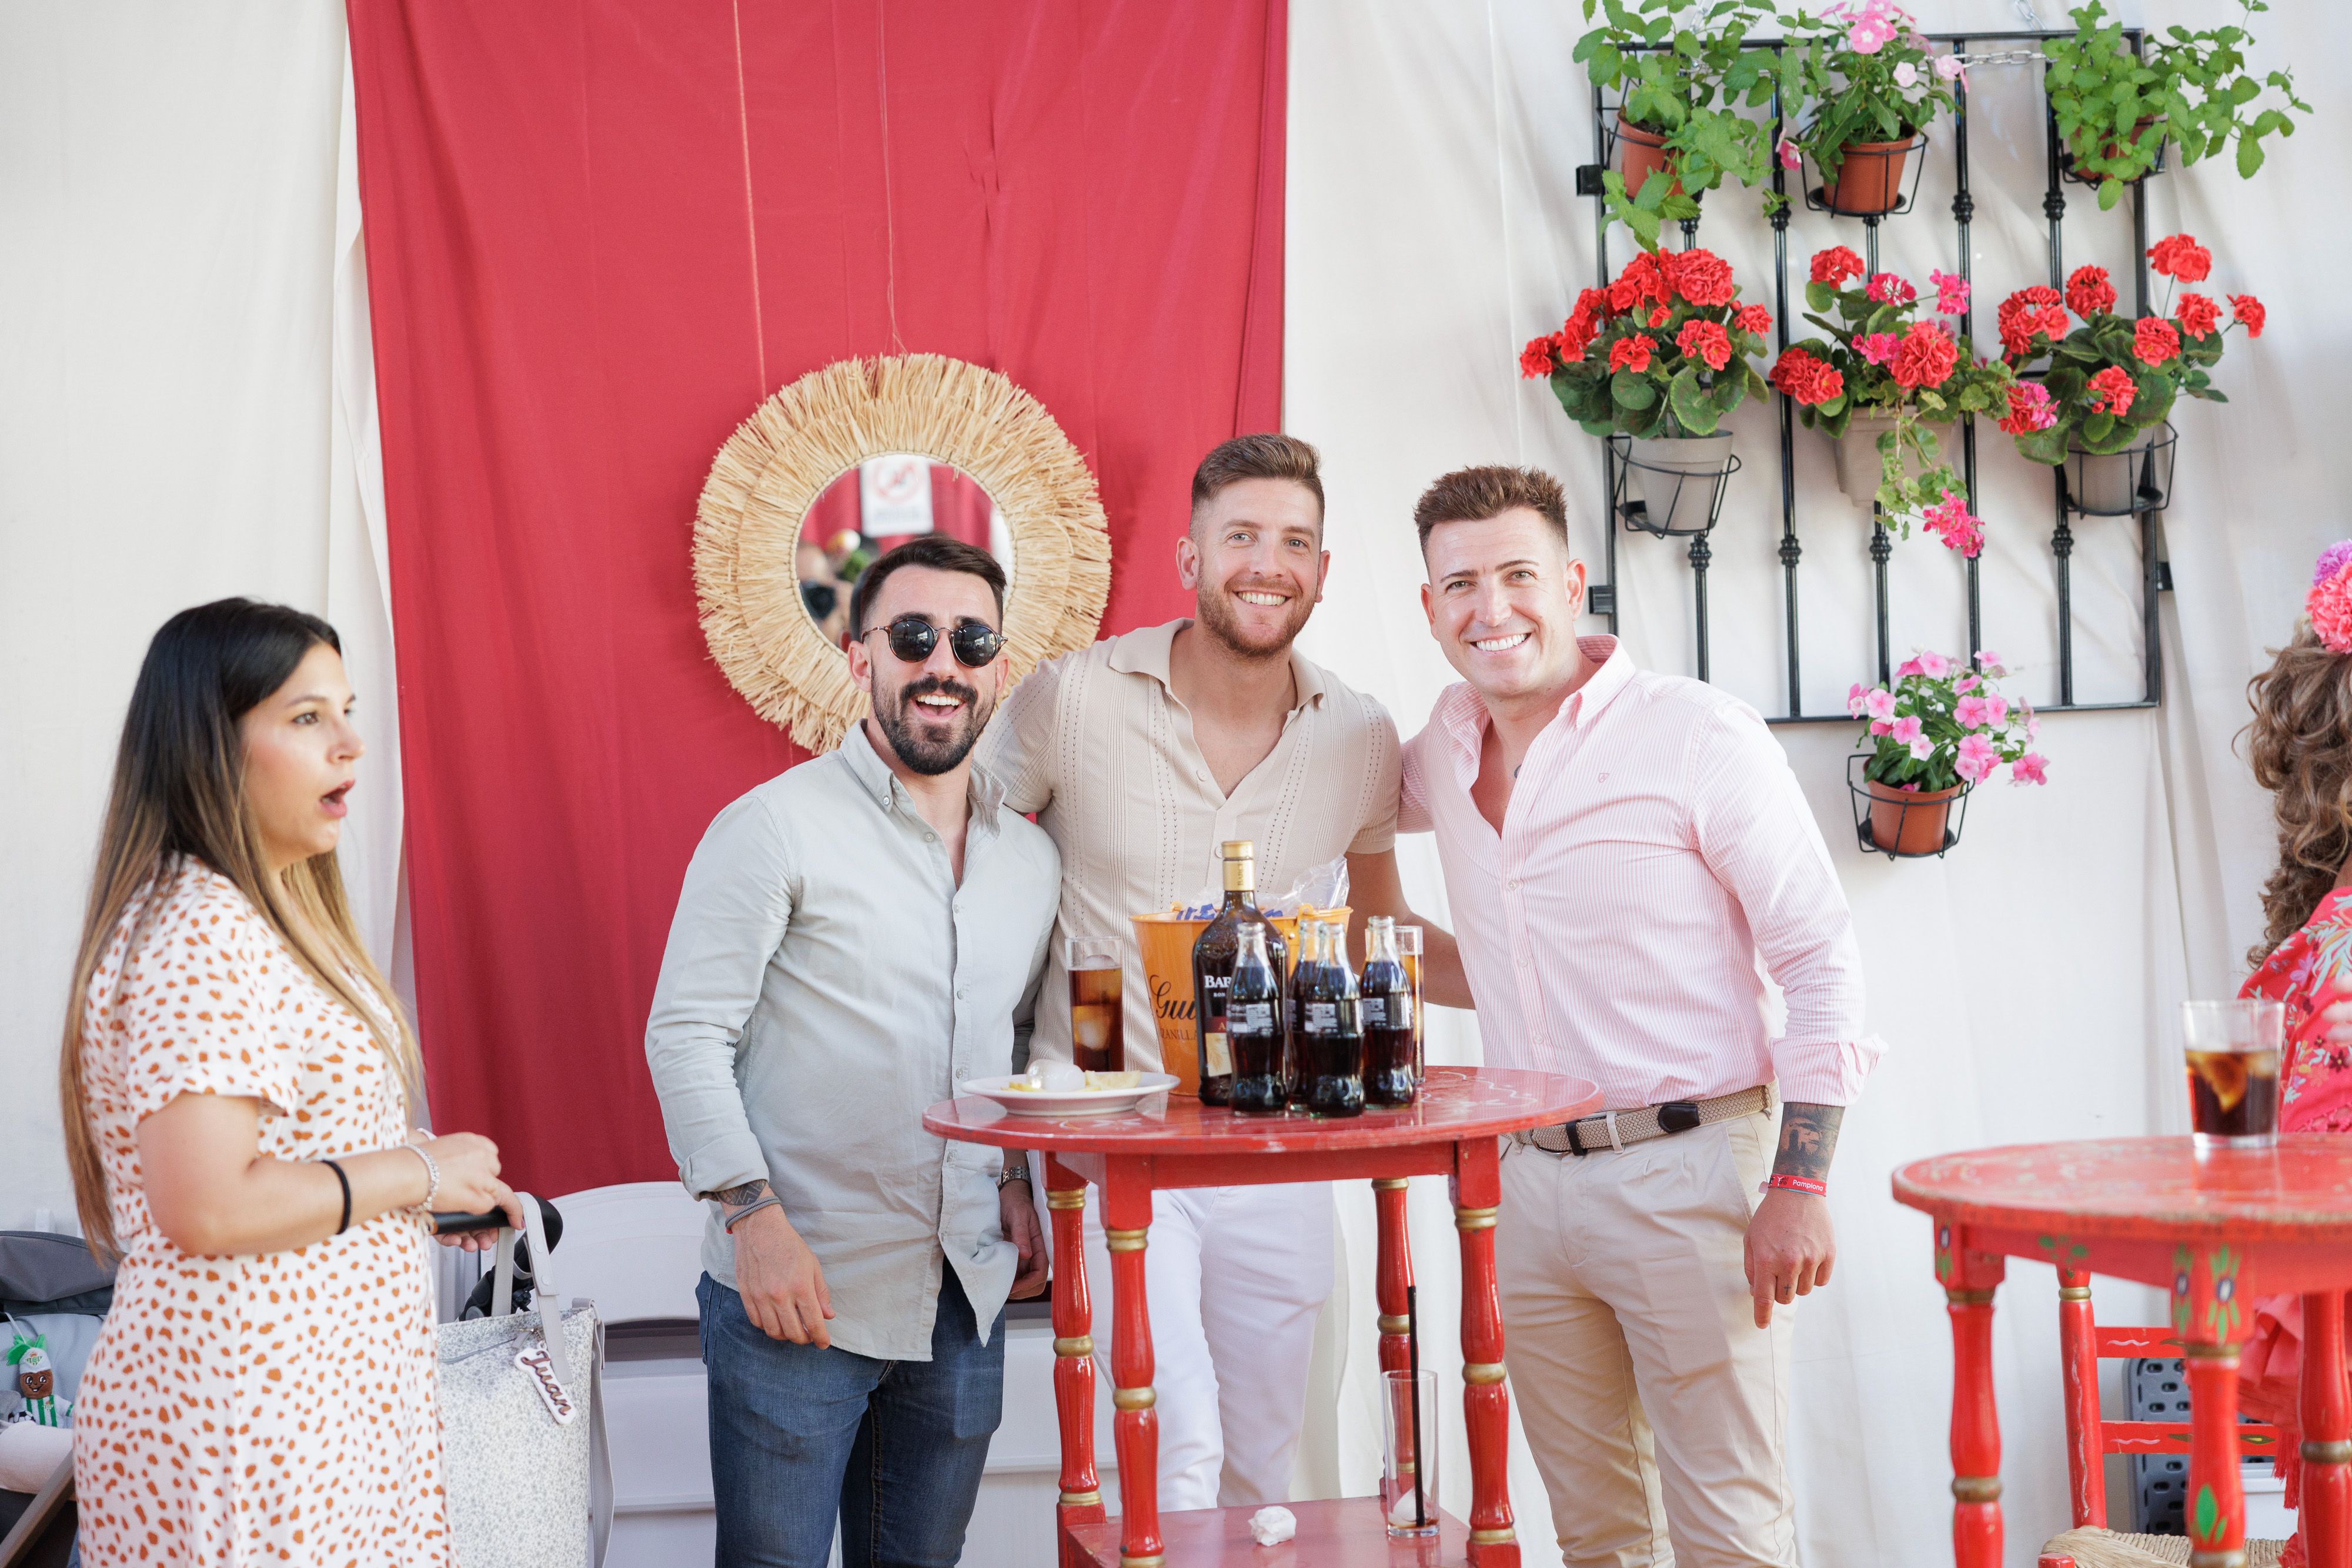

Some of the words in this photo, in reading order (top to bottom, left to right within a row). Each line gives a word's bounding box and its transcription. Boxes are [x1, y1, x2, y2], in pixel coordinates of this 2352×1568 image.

[1204, 975, 1232, 988] BAR
[1150, 974, 1197, 1020] Gui
[1792, 1179, 1823, 1191] Pamplona
[520, 1350, 572, 1416] Juan
